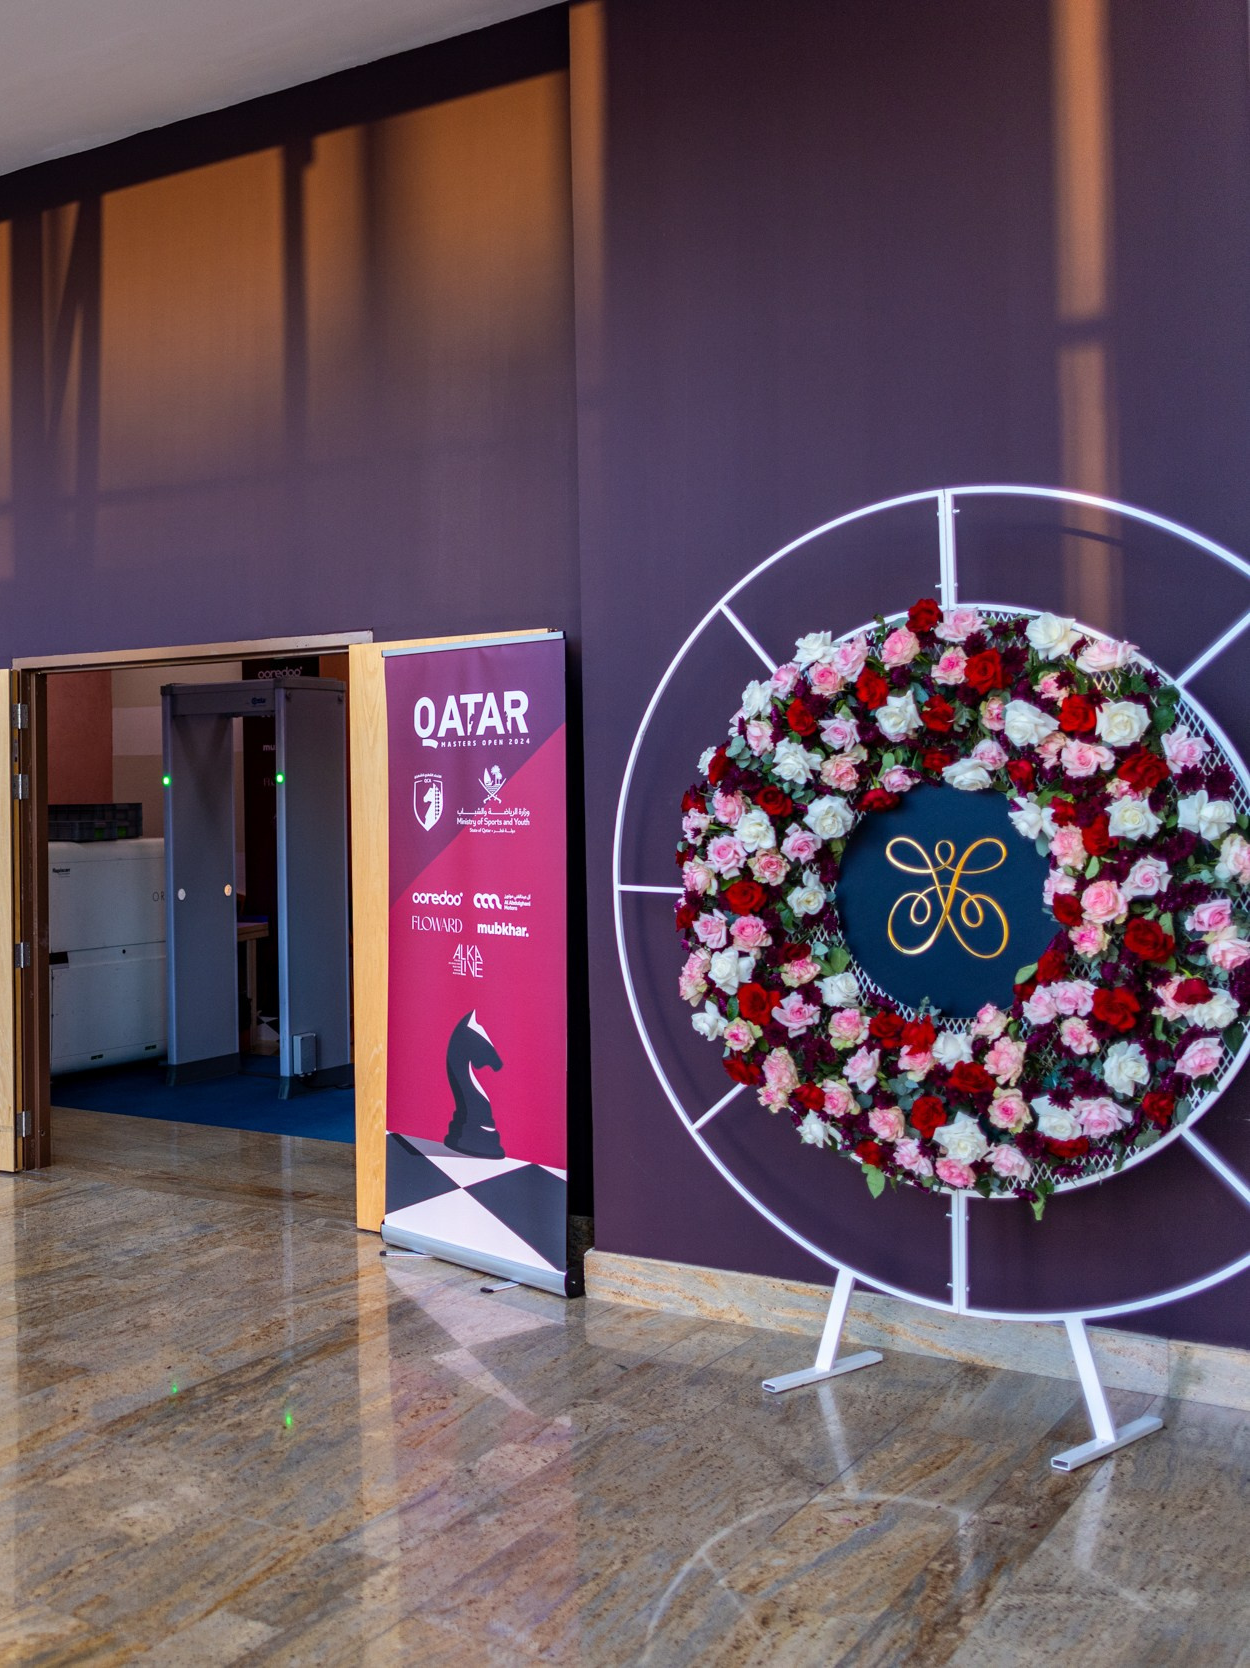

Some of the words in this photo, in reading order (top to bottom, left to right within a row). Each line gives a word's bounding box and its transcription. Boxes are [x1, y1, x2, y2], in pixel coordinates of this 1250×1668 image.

[414, 690, 529, 749] QATAR
[441, 740, 477, 748] MASTERS
[456, 817, 477, 827] Ministry
[477, 817, 484, 826] of
[484, 817, 502, 827] Sports
[503, 818, 513, 826] and
[513, 817, 530, 826] Youth
[412, 890, 463, 906] ooredoo
[412, 915, 463, 933] FLOWARD
[477, 922, 529, 937] mubkhar.
[453, 944, 483, 961] ALKA
